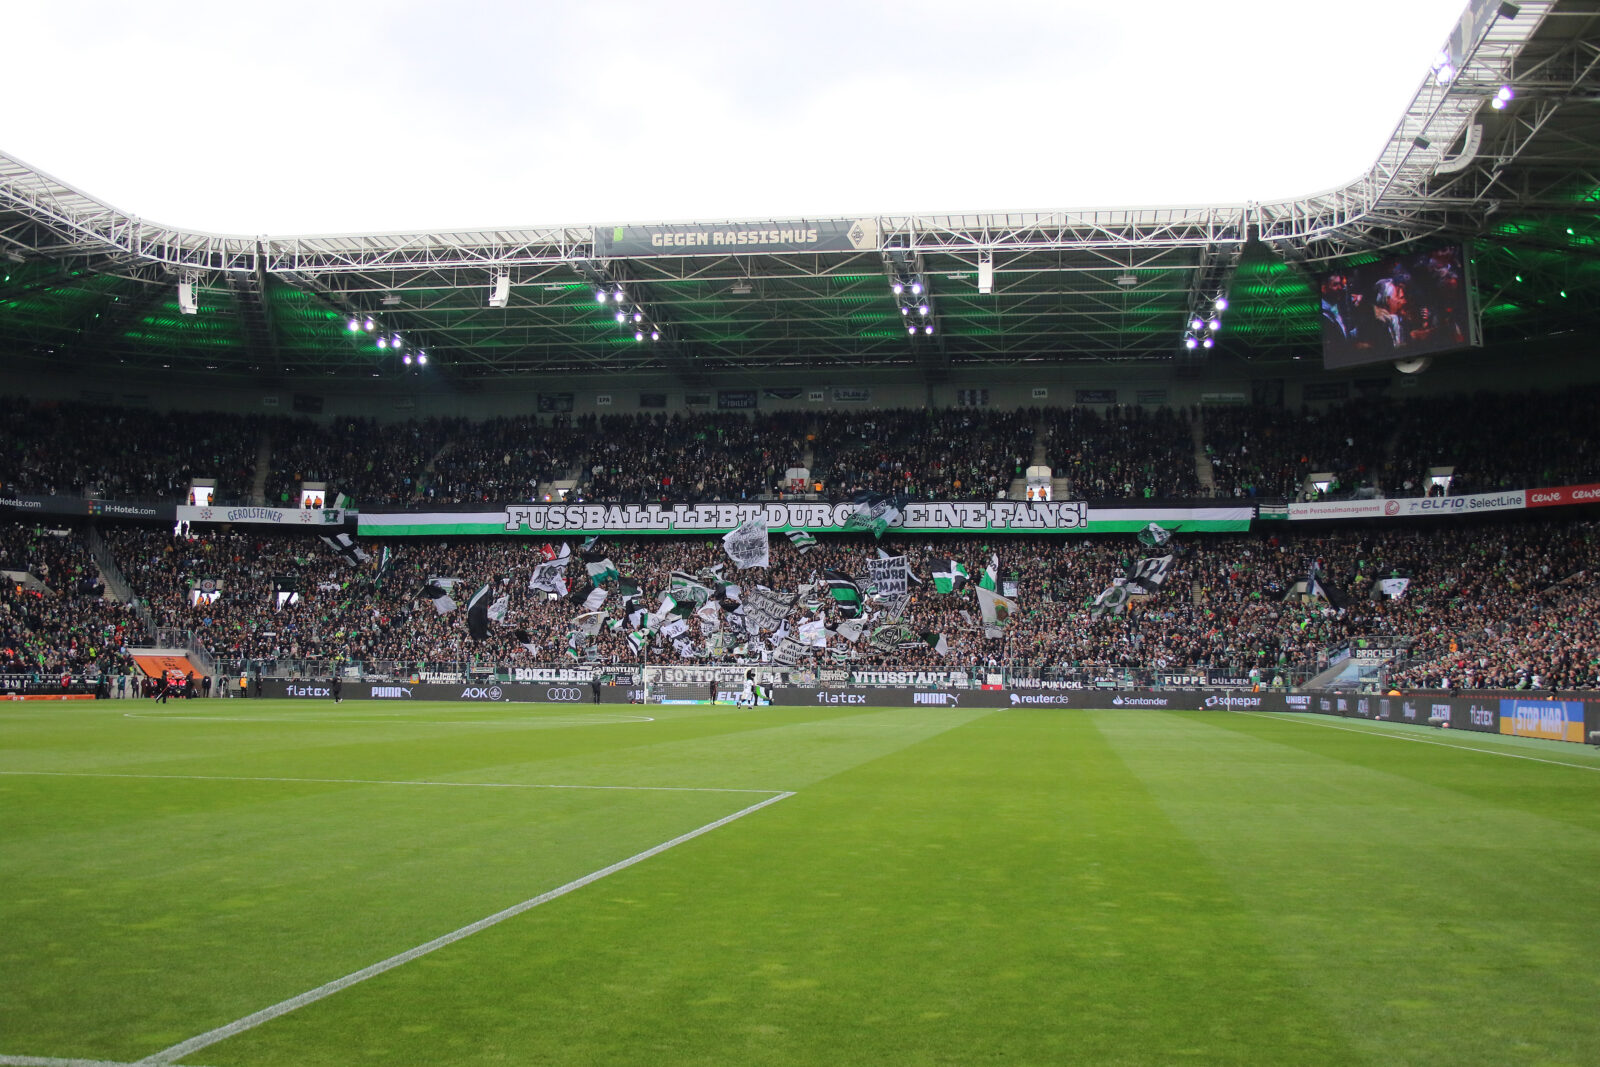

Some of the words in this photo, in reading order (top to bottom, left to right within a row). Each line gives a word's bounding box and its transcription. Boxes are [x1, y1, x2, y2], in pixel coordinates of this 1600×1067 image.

[652, 231, 708, 247] GEGEN
[713, 229, 818, 246] RASSISMUS
[1470, 496, 1522, 509] SelectLine
[1531, 491, 1561, 503] cewe
[105, 504, 156, 515] H-Hotels.com
[227, 507, 283, 523] GEROLSTEINER
[1310, 505, 1380, 514] Personalmanagement
[505, 504, 670, 531] FUSSBALL
[672, 503, 762, 530] LEBT
[765, 502, 862, 529] DURC
[991, 501, 1088, 529] FANS!
[852, 671, 948, 684] VITUSSTADT
[1010, 678, 1040, 688] PINKIS
[1164, 676, 1206, 685] FUPPE
[286, 685, 330, 697] flatex
[371, 687, 401, 698] PUMA
[461, 687, 489, 699] AOK
[816, 692, 866, 703] flatex
[914, 692, 947, 704] PUMA
[1021, 693, 1069, 704] reuter.de
[1124, 696, 1168, 706] Santander
[1218, 696, 1262, 707] sonepar
[1285, 695, 1312, 705] UNIBET
[1470, 704, 1494, 726] flatex
[1517, 706, 1539, 731] STOP
[1541, 707, 1562, 733] WAR
